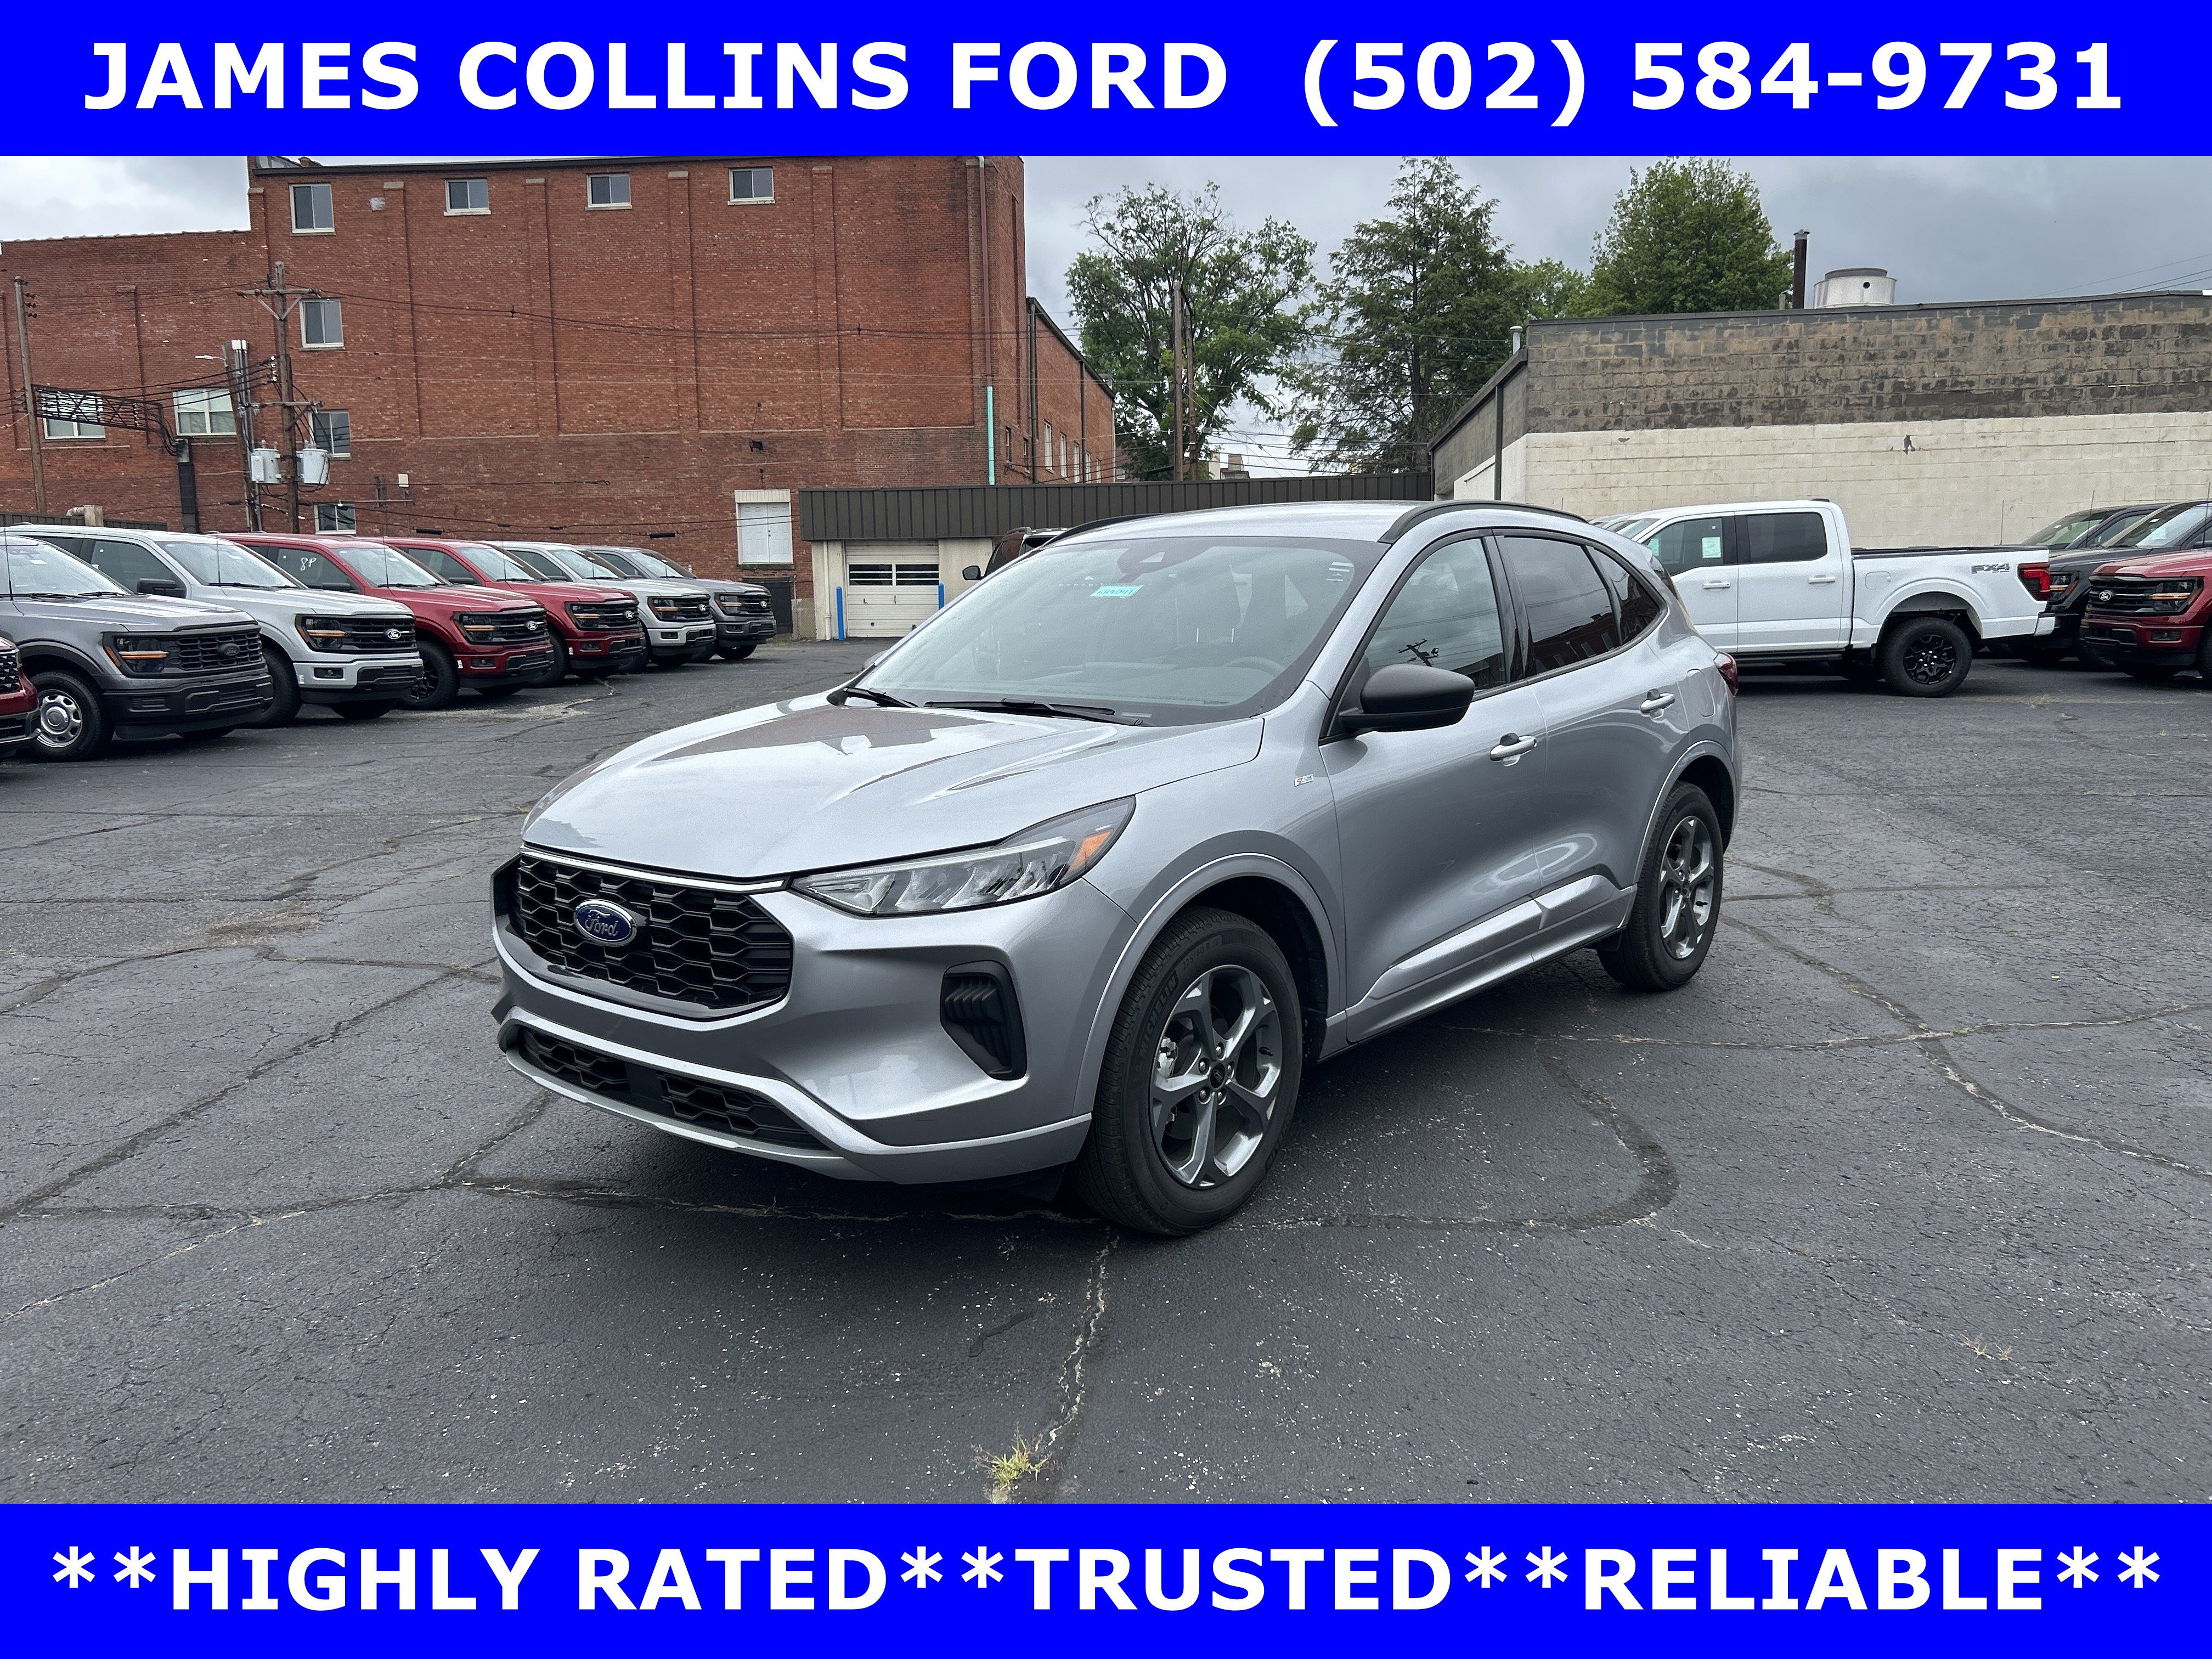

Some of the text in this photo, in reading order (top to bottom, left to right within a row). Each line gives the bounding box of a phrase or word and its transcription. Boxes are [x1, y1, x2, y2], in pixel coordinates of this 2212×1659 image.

[300, 557, 317, 571] 8P
[1971, 563, 2010, 574] FX4
[585, 909, 619, 937] Ford
[1182, 946, 1205, 970] 225/60
[1139, 975, 1177, 1057] MICHELIN
